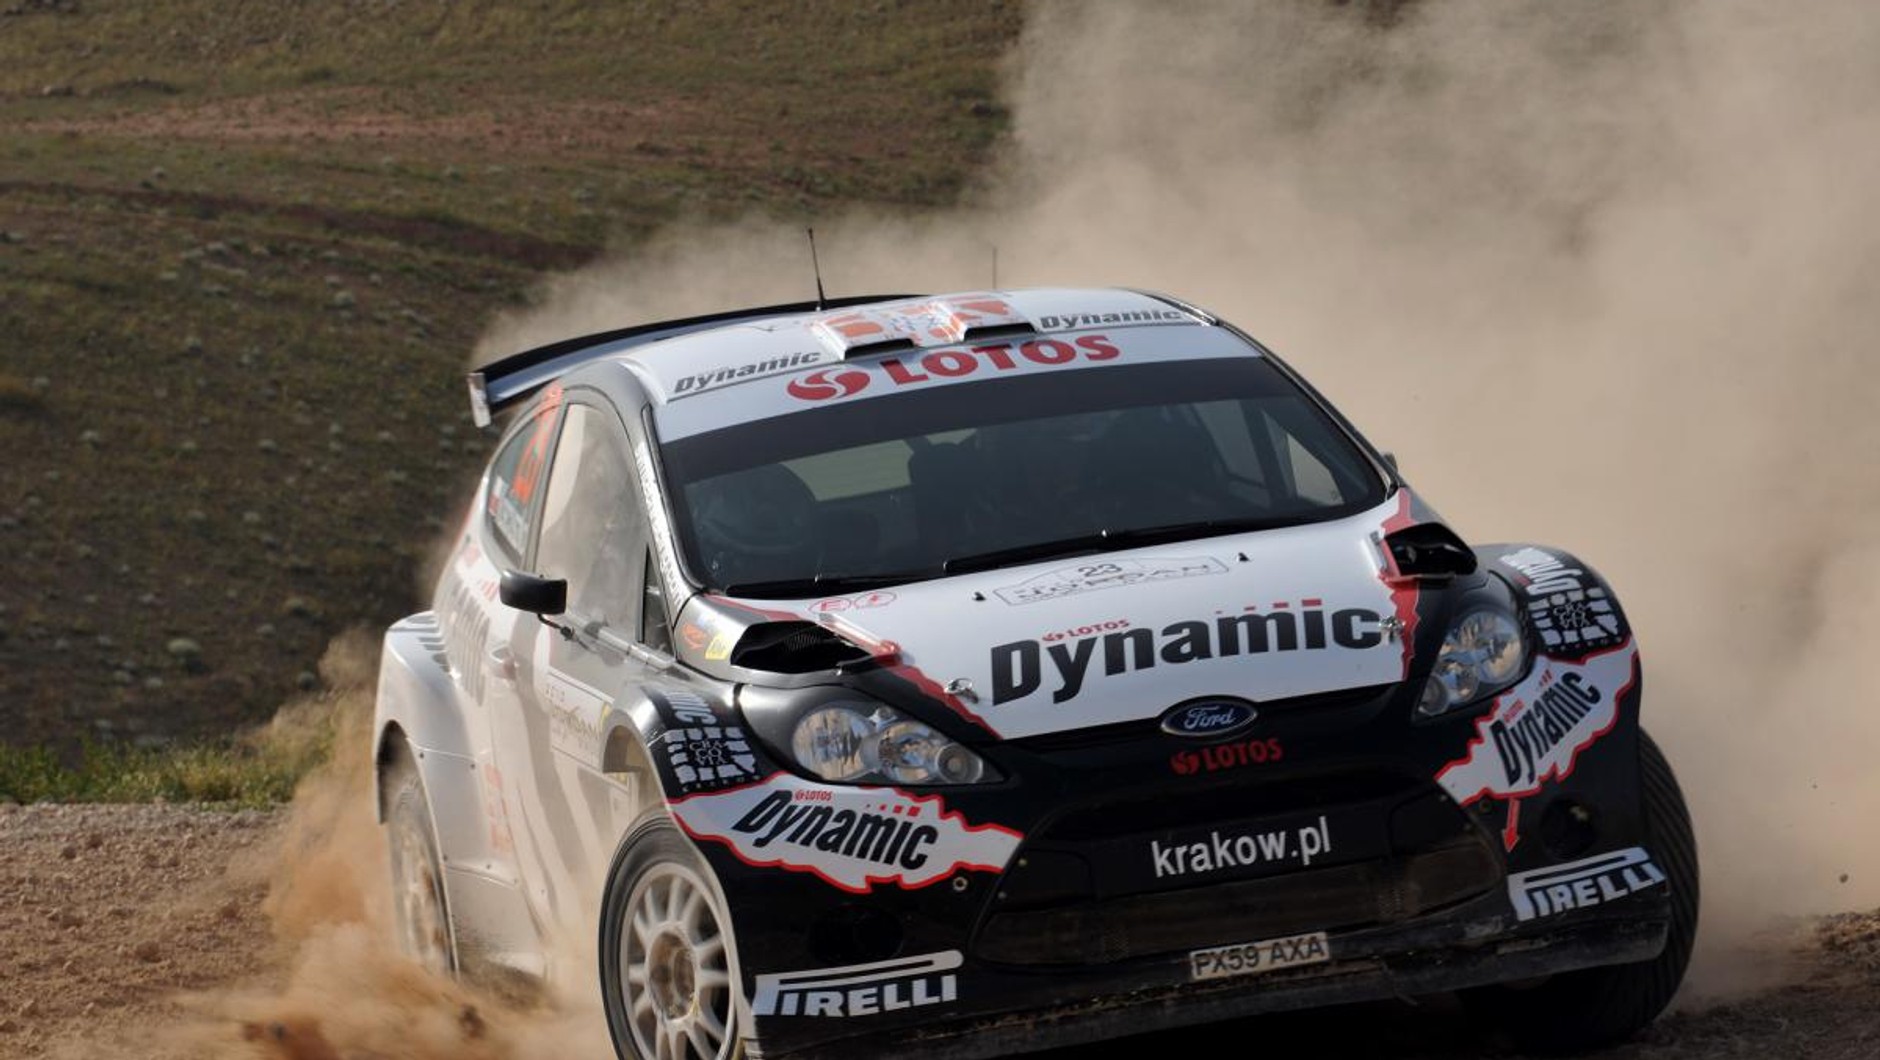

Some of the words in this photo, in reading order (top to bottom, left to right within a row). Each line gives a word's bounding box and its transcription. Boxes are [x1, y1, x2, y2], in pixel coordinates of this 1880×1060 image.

[1041, 309, 1182, 330] Dynamic
[674, 351, 821, 393] Dynamic
[879, 335, 1122, 386] LOTOS
[1078, 563, 1123, 578] 23
[1066, 618, 1131, 639] LOTOS
[990, 598, 1382, 706] Dynamic
[1184, 704, 1237, 730] Ford
[1489, 671, 1602, 787] Dynamic
[1202, 738, 1283, 772] LOTOS
[805, 790, 833, 802] LOTOS
[731, 789, 939, 870] Dynamic
[1151, 815, 1332, 877] krakow.pl
[1508, 846, 1667, 921] PIRELLI
[1194, 945, 1260, 977] PX59
[1269, 935, 1325, 965] AXA
[751, 949, 964, 1018] PIRELLI
